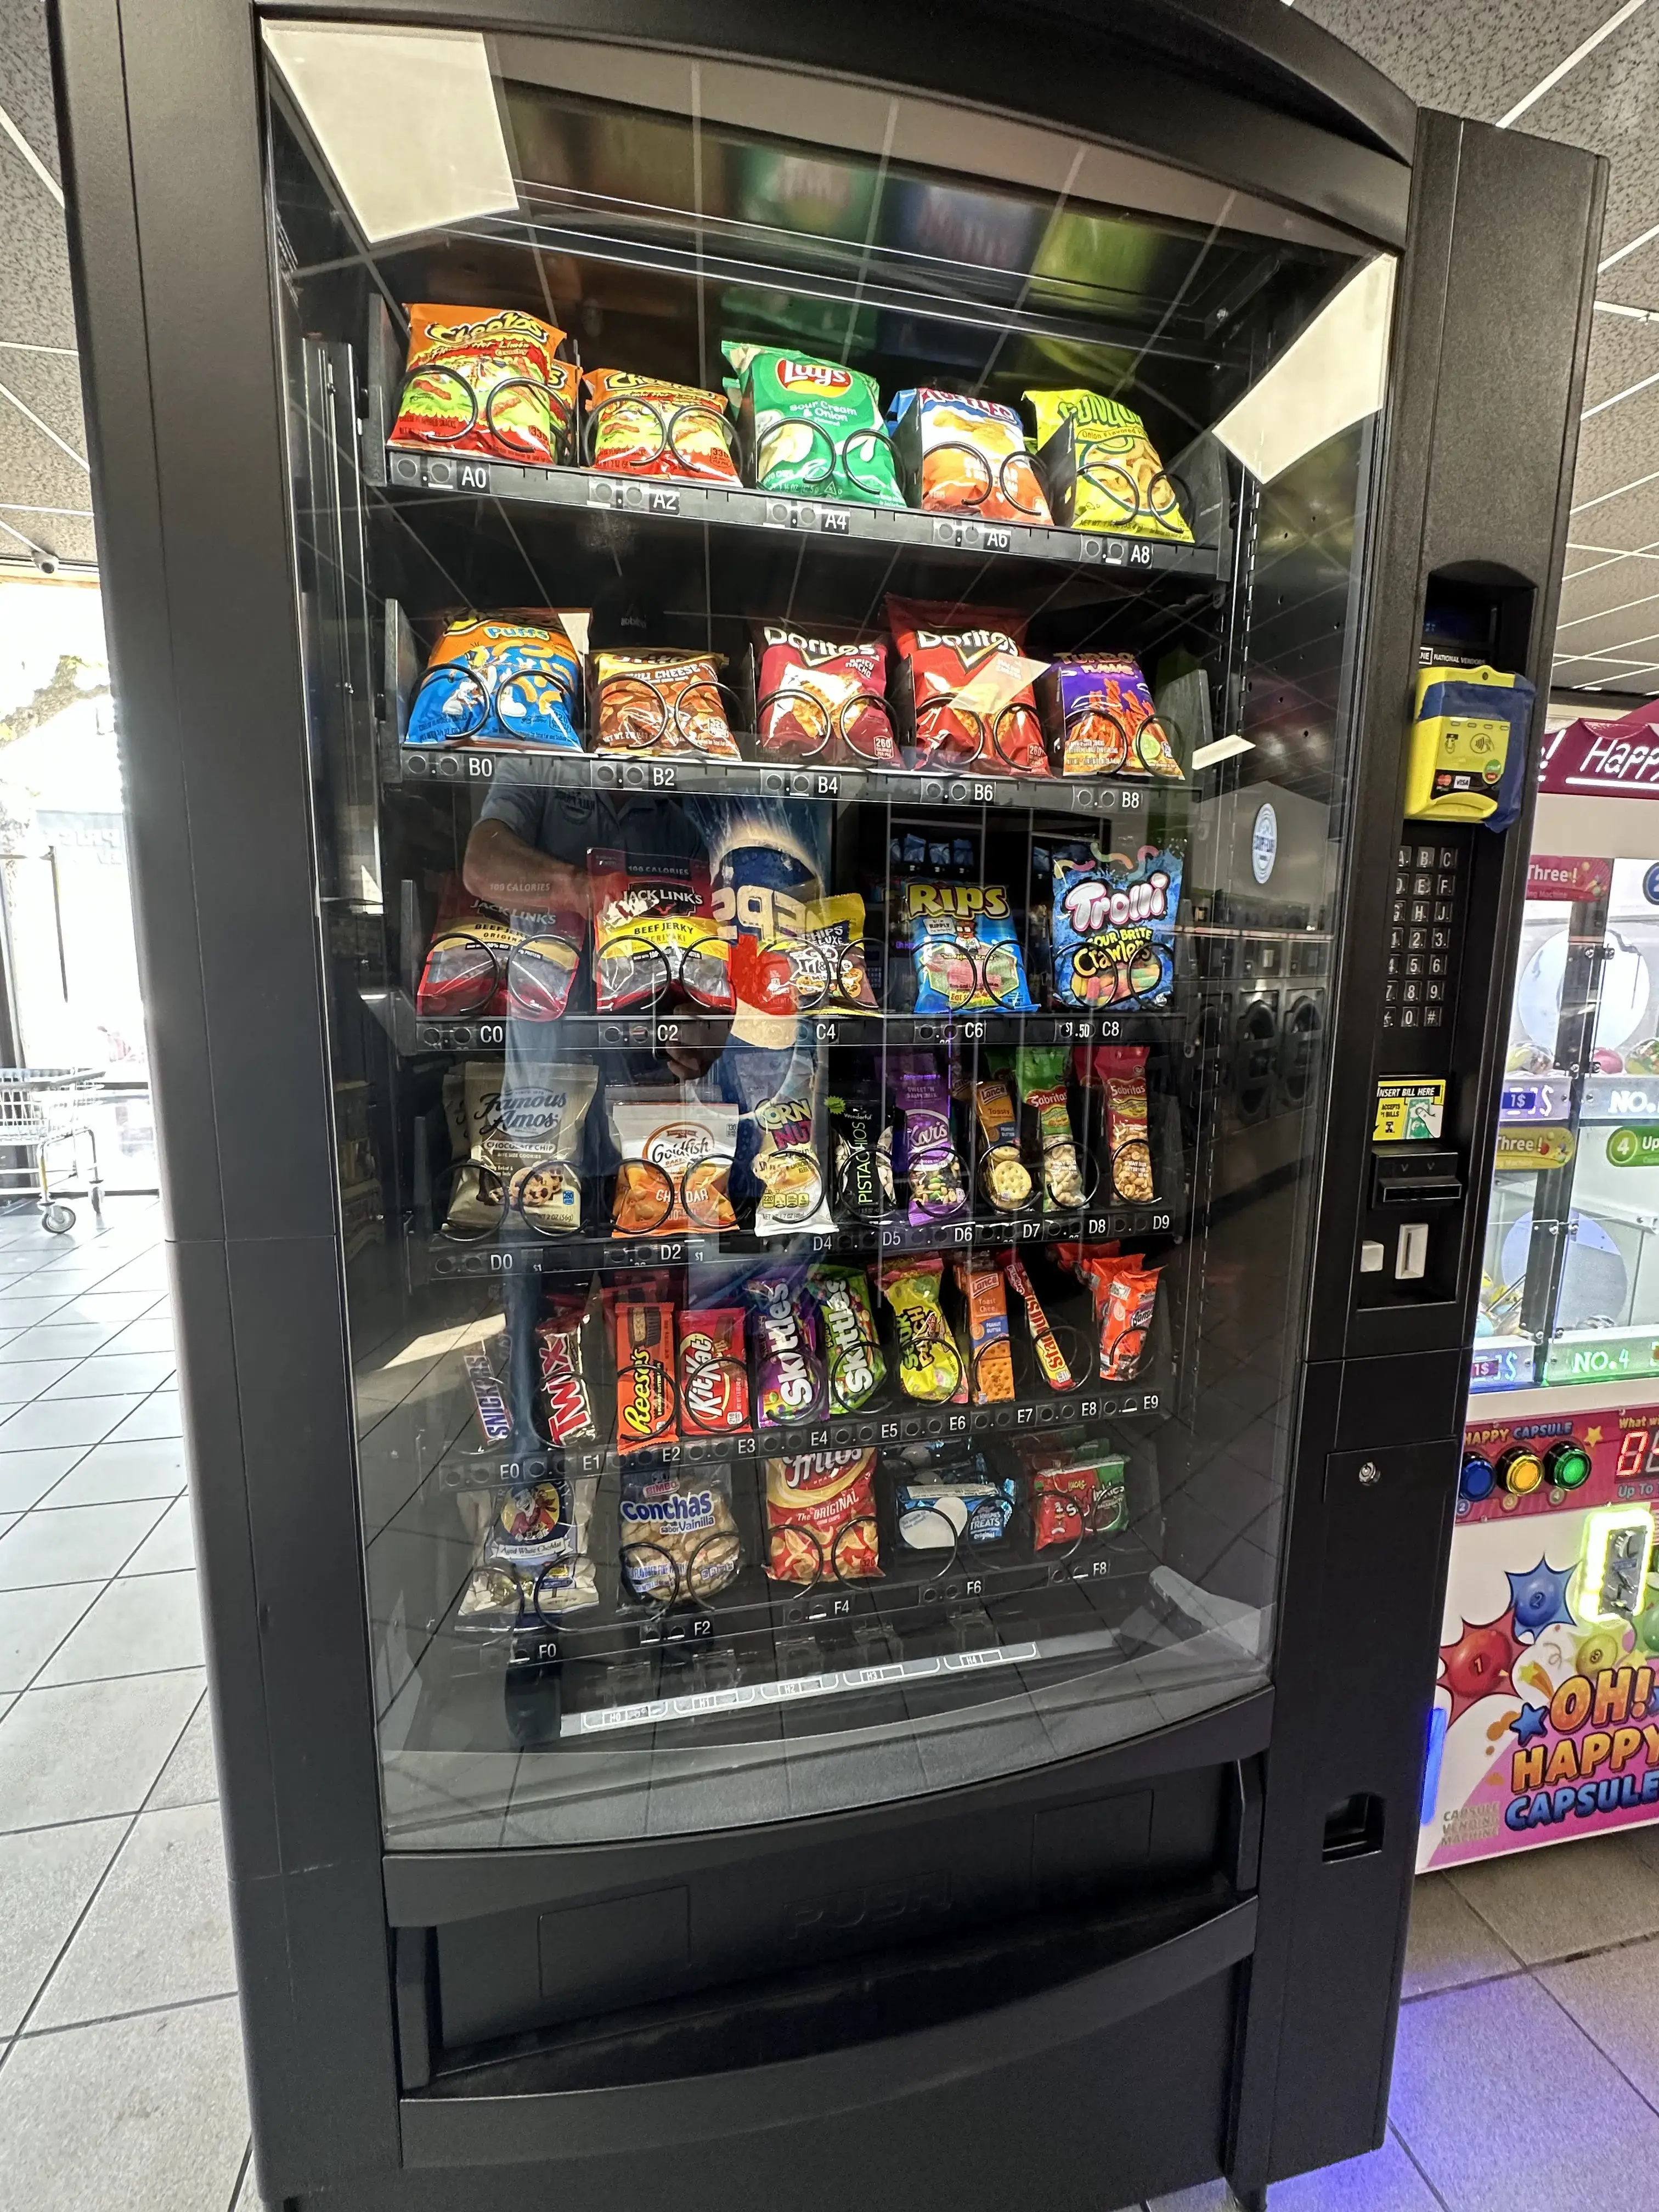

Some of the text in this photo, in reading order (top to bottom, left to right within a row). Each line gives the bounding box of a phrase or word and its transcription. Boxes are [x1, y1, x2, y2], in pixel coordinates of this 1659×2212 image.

[426, 311, 548, 343] Cheetos
[789, 400, 857, 416] Sour Cream
[803, 407, 848, 422] & Onion
[1082, 427, 1136, 439] Onion Flavored
[462, 468, 486, 488] A0
[653, 494, 676, 510] A2
[825, 515, 847, 530] A4
[987, 533, 1008, 548] A6
[1131, 545, 1150, 563] A8
[764, 626, 876, 657] Doritos
[916, 629, 1019, 657] Doritos
[1053, 652, 1135, 664] TURBO
[654, 663, 702, 679] CHEESE
[876, 738, 891, 748] 260
[1029, 744, 1042, 757] 260
[469, 757, 493, 777] B0
[653, 768, 675, 786] B2
[818, 776, 838, 794] B4
[974, 783, 994, 802] B6
[1122, 791, 1140, 809] B8
[1420, 851, 1451, 867] B C
[645, 866, 689, 875] CALORIES
[507, 883, 550, 891] CALORIES
[1418, 878, 1448, 894] E F
[659, 889, 703, 905] LINK'S
[909, 884, 1008, 917] Rips
[1065, 871, 1168, 932] Trolli
[470, 900, 510, 917] JACK
[1415, 905, 1446, 921] H J
[634, 923, 694, 935] BEEF JERKY
[1121, 927, 1153, 942] BRITE
[1413, 932, 1443, 947] 2 3
[1073, 939, 1150, 977] Crawlers
[1410, 958, 1441, 973] 5 6
[1407, 985, 1438, 1000] 8 9
[1405, 1010, 1413, 1025] 0
[480, 1025, 504, 1043] C0
[657, 1024, 679, 1042] C2
[816, 1023, 836, 1040] C4
[964, 1022, 984, 1038] C6
[1102, 1022, 1120, 1037] C8
[982, 1085, 1007, 1099] Lance
[1111, 1085, 1146, 1097] Sabritas
[1376, 1087, 1435, 1098] INSERT BILL HERE
[473, 1091, 567, 1121] Famous
[1031, 1092, 1067, 1108] Sabritas
[479, 1109, 558, 1135] Amos
[486, 1141, 554, 1152] CHOCOLATE CHIP
[652, 1138, 709, 1164] Goldfish
[1617, 1136, 1629, 1155] 4
[852, 1121, 873, 1205] PISTACHIOS
[1088, 1219, 1106, 1234] D8
[1153, 1215, 1170, 1229] D9
[955, 1227, 973, 1242] D6
[1023, 1223, 1041, 1238] D7
[813, 1236, 832, 1251] D4
[882, 1232, 901, 1246] D5
[660, 1243, 681, 1260] D2
[695, 1251, 704, 1262] $1
[490, 1253, 513, 1271] D0
[972, 1273, 1000, 1295] Lance
[978, 1297, 996, 1306] Toast
[826, 1279, 873, 1393] Skittles
[1025, 1294, 1064, 1369] Starburst
[764, 1282, 813, 1406] Skittles
[895, 1314, 919, 1370] SOUR
[466, 1355, 510, 1440] SNICKERS
[539, 1338, 591, 1446] TWIX
[623, 1347, 652, 1435] Reese's
[1081, 1402, 1097, 1417] E8
[1143, 1395, 1159, 1410] E9
[950, 1415, 966, 1431] E6
[1017, 1408, 1034, 1423] E7
[1618, 1417, 1646, 1430] What
[811, 1431, 828, 1446] E4
[881, 1423, 898, 1438] E5
[1464, 1421, 1573, 1447] HAPPY CAPSULE
[662, 1446, 681, 1462] E2
[738, 1438, 755, 1454] E3
[583, 1454, 600, 1471] E1
[500, 1463, 520, 1480] E0
[646, 1481, 679, 1495] BIMBO
[1617, 1482, 1654, 1499] Up To
[622, 1492, 713, 1520] Conchas
[797, 1491, 860, 1521] The ORIGINAL
[1458, 1503, 1466, 1511] 2
[1506, 1498, 1514, 1506] 3
[661, 1516, 715, 1533] sabor Vainilla
[970, 1517, 1001, 1530] TREATS
[973, 1531, 995, 1541] original
[500, 1541, 562, 1555] Aged White Cheddar
[1093, 1562, 1107, 1576] F8
[967, 1581, 982, 1594] F6
[834, 1600, 850, 1615] F4
[1533, 1592, 1543, 1607] 2
[694, 1621, 710, 1635] F2
[539, 1644, 556, 1658] F0
[1592, 1649, 1601, 1661] 3
[966, 1655, 978, 1666] H4
[1472, 1657, 1483, 1674] 1
[866, 1670, 878, 1680] H3
[785, 1684, 795, 1694] H2
[699, 1698, 710, 1708] H1
[1550, 1667, 1654, 1734] OH!
[610, 1712, 622, 1722] H0
[1511, 1725, 1659, 1794] HAPPY
[1505, 1769, 1659, 1831] CAPSULE
[1443, 1803, 1499, 1822] CAPSULE
[1442, 1815, 1499, 1835] VENDING
[1441, 1828, 1499, 1846] MACHINE
